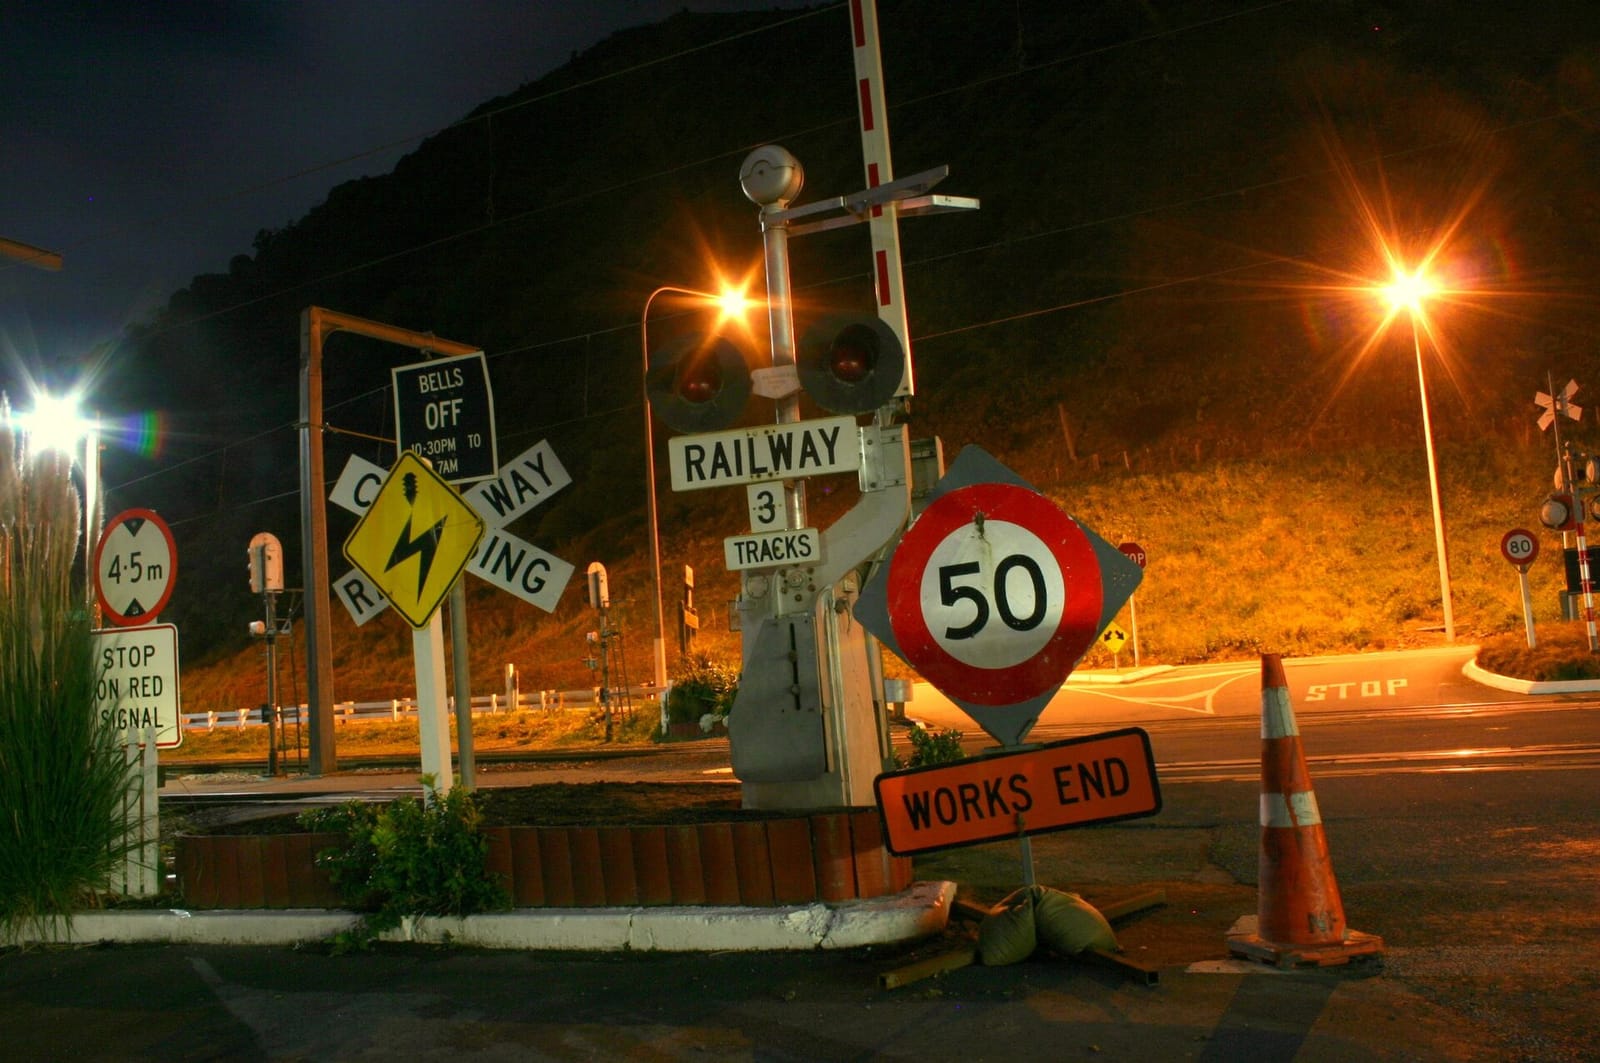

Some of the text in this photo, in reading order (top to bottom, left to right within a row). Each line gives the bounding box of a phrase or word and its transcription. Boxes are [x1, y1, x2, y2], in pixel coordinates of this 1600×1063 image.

[419, 368, 464, 394] BELLS
[425, 398, 463, 430] OFF
[468, 433, 481, 448] TO
[437, 459, 458, 474] 7AM
[684, 426, 840, 482] RAILWAY
[757, 490, 776, 524] 3
[734, 534, 812, 565] TRACKS
[1510, 540, 1531, 553] 80
[470, 535, 551, 594] ING
[938, 553, 1047, 640] 50
[103, 645, 155, 669] STOP
[97, 675, 163, 700] ON RED
[1304, 678, 1408, 701] STOP
[100, 706, 164, 730] SIGNAL
[902, 757, 1130, 831] WORKS END
